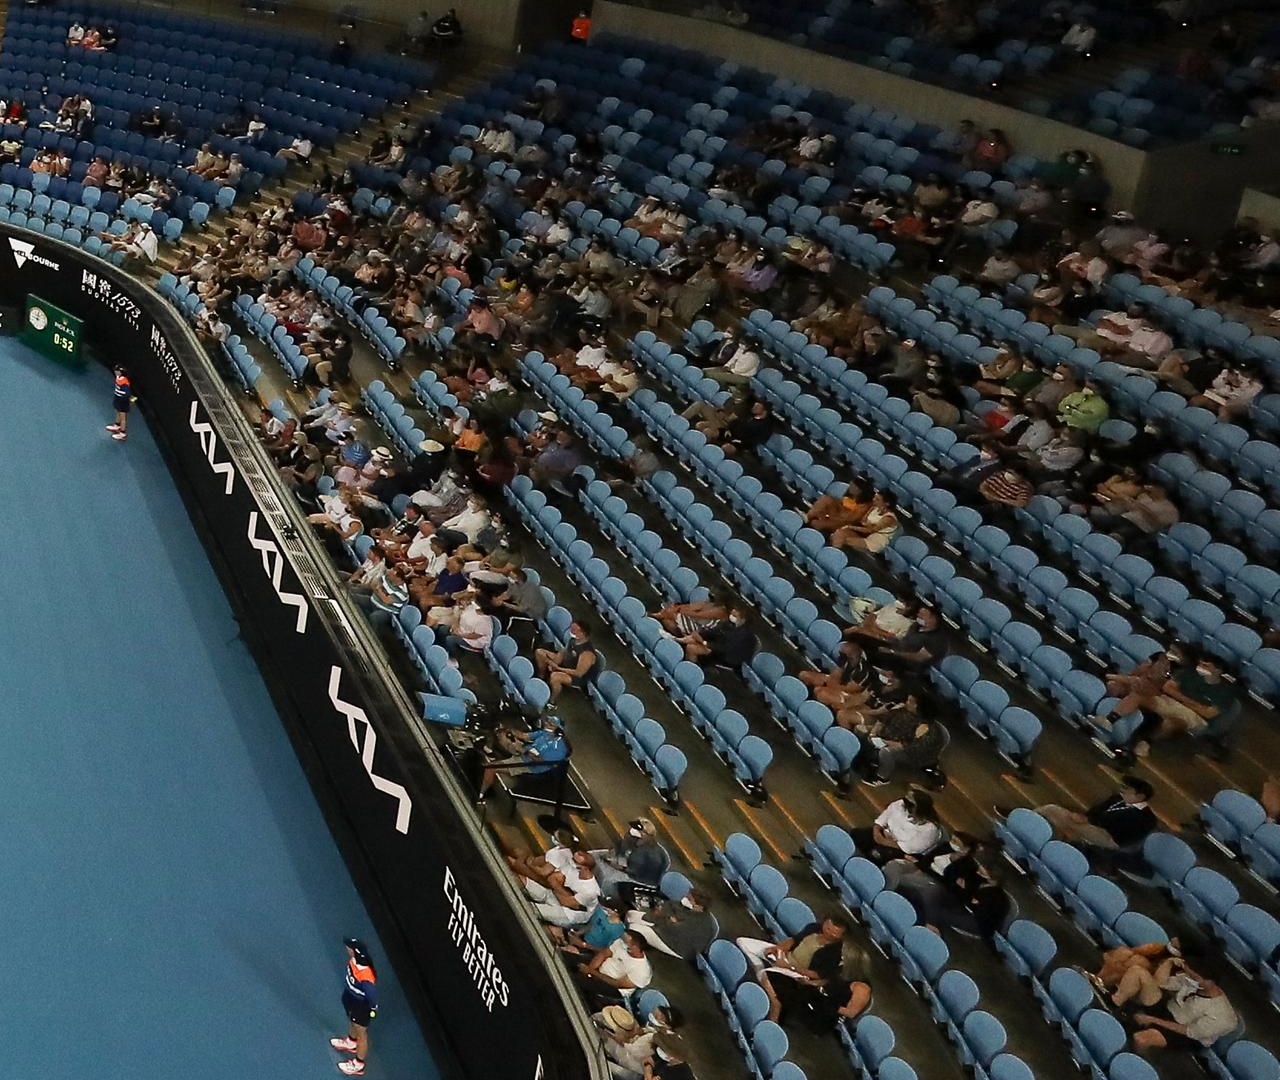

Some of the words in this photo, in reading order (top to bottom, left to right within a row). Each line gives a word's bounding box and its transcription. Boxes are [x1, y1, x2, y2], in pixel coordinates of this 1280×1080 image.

[53, 332, 74, 353] 0:52
[443, 865, 510, 1008] Emirates
[447, 912, 465, 948] FLY
[462, 941, 496, 1013] BETTER
